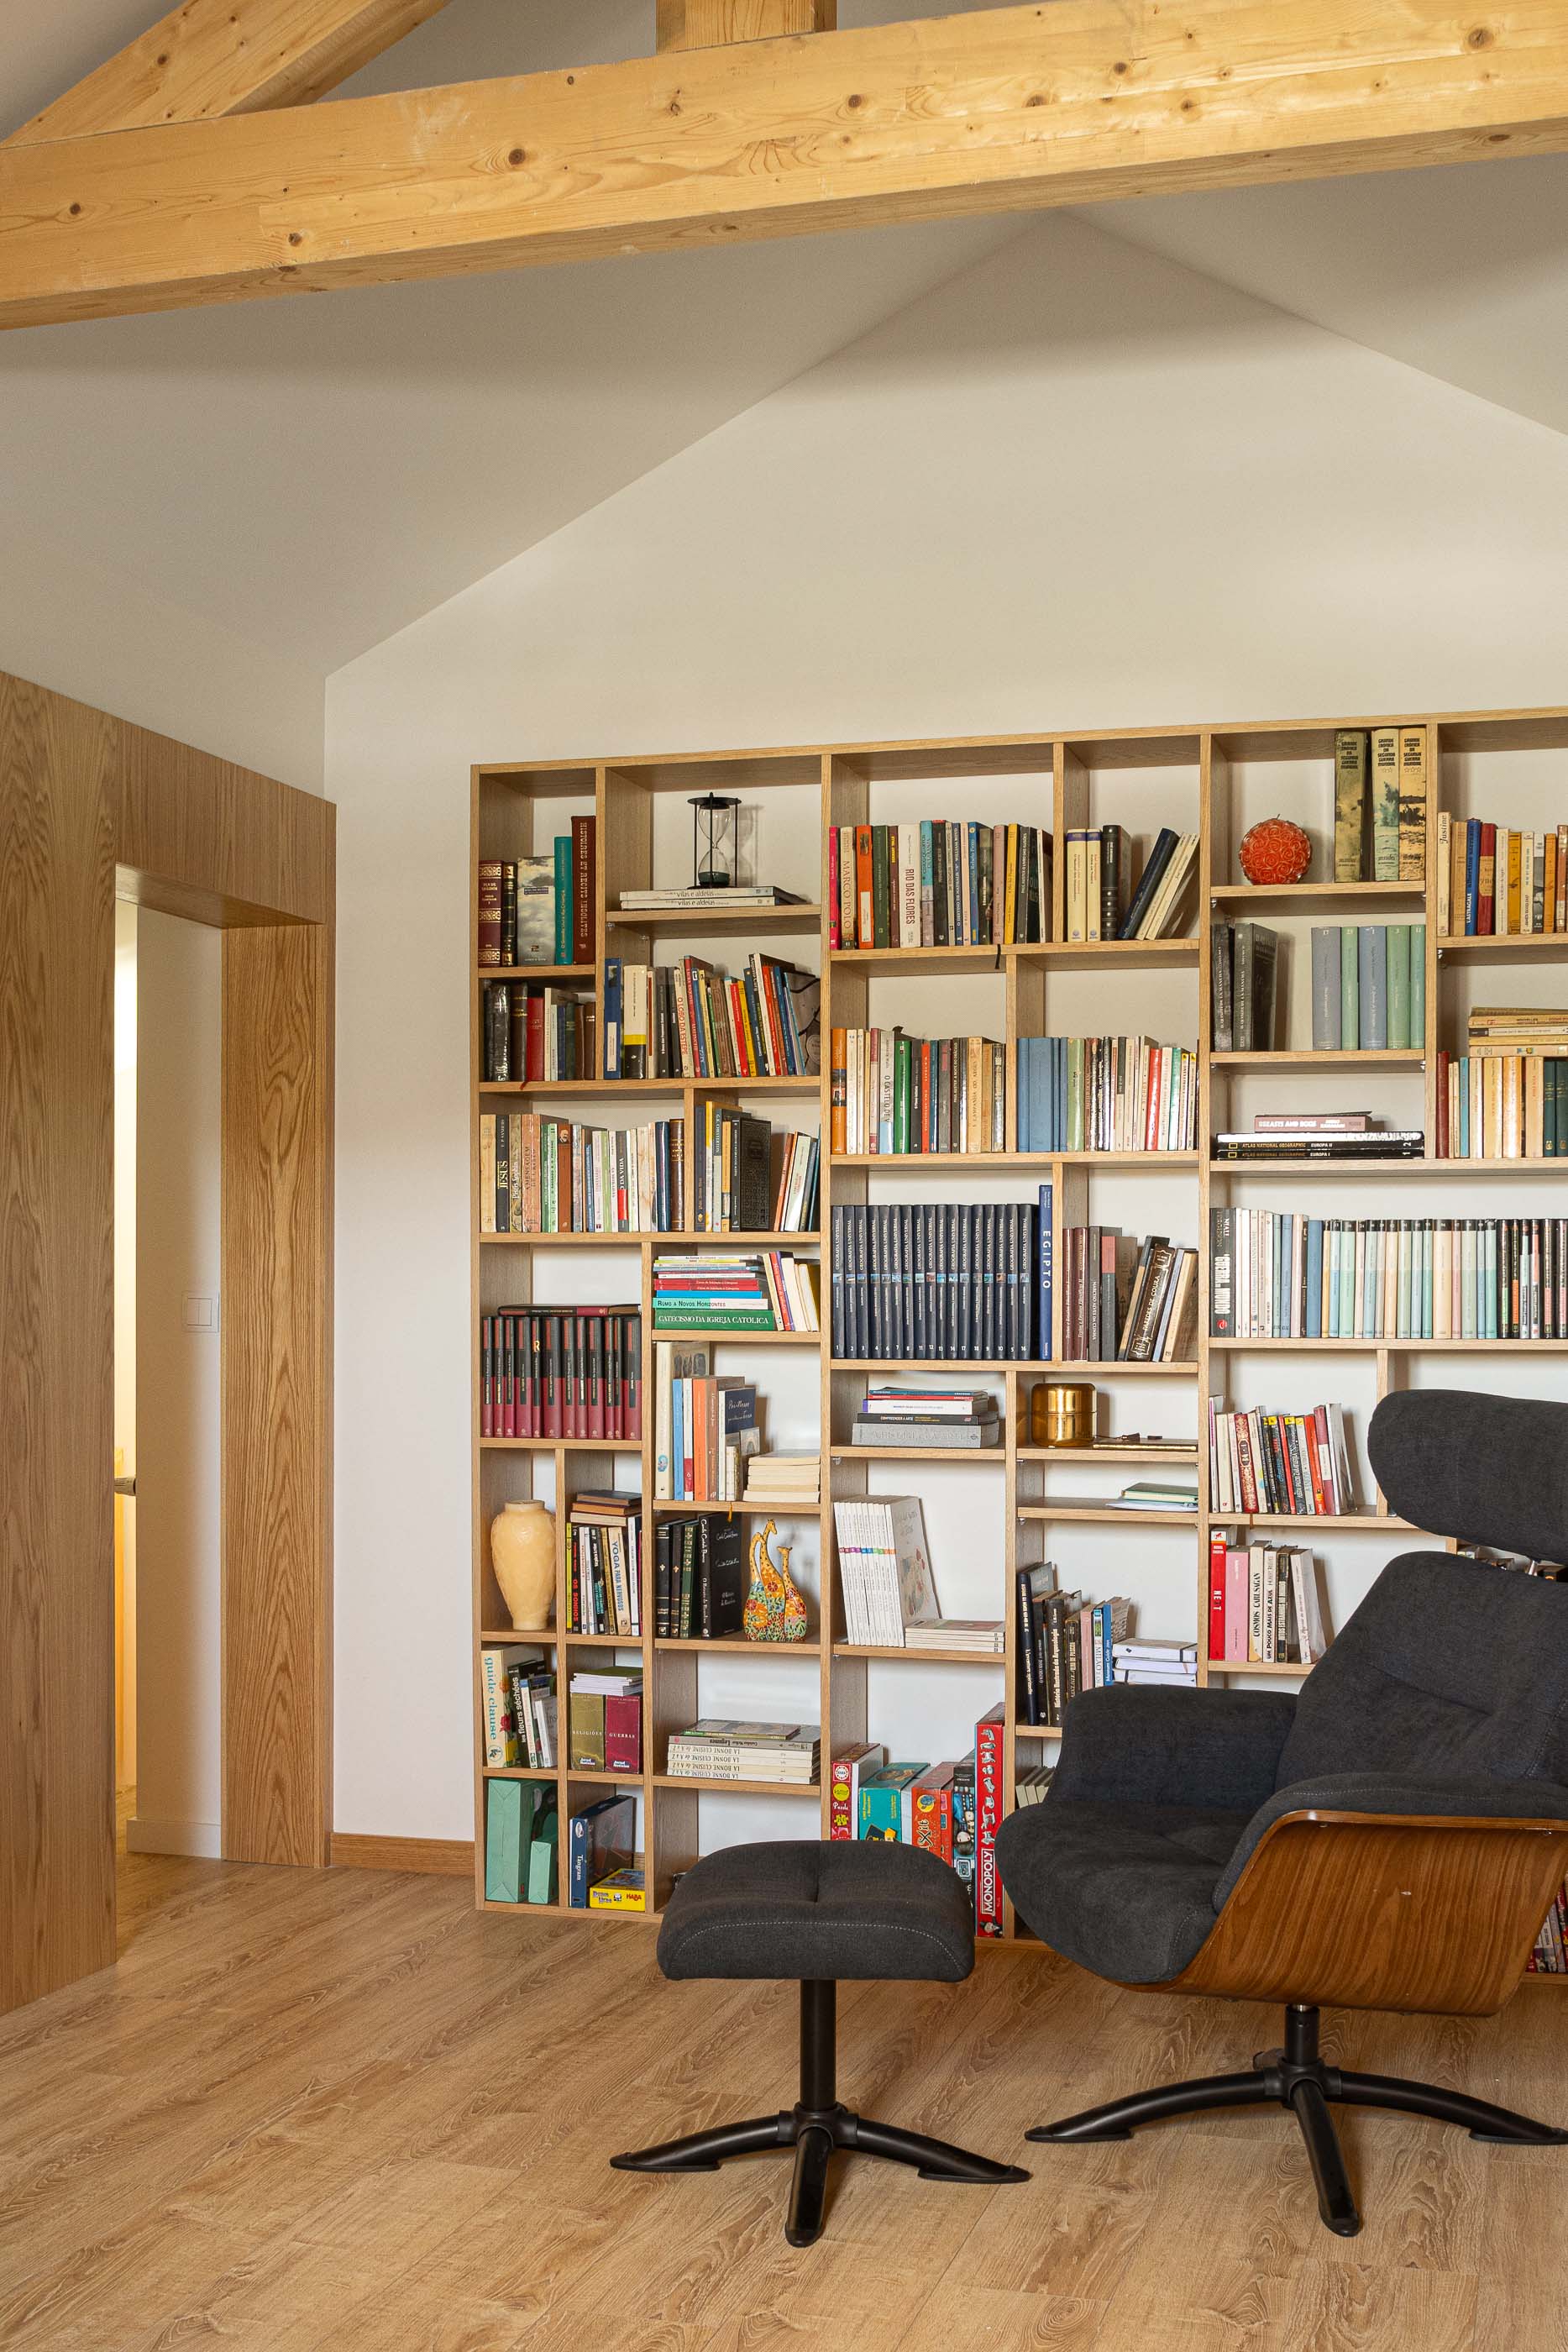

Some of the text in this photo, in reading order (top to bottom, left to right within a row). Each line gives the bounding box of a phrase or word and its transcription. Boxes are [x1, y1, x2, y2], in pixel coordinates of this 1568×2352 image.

[1440, 815, 1448, 844] Justine
[580, 861, 588, 870] ET
[842, 860, 852, 928] MARCO POLO
[906, 869, 915, 924] RIO DAS FLORES
[680, 1022, 686, 1031] DA
[499, 1161, 508, 1189] JESUS
[619, 1175, 625, 1185] DA
[1043, 1230, 1051, 1289] EGIPTO
[1215, 1256, 1230, 1314] GUERRA MUNDO
[1142, 1308, 1153, 1332] PAREDES
[1150, 1277, 1160, 1298] COURA
[732, 1316, 768, 1324] CATÓLICA
[573, 1579, 578, 1589] OS
[616, 1585, 624, 1611] NERVOSOS
[1051, 1628, 1060, 1658] Arqueologia
[1267, 1651, 1272, 1659] UM
[484, 1657, 498, 1739] guide clause
[511, 1677, 525, 1734] fleurs séchées
[575, 1854, 583, 1881] Tangram
[983, 1851, 993, 1912] MONOPOLY
